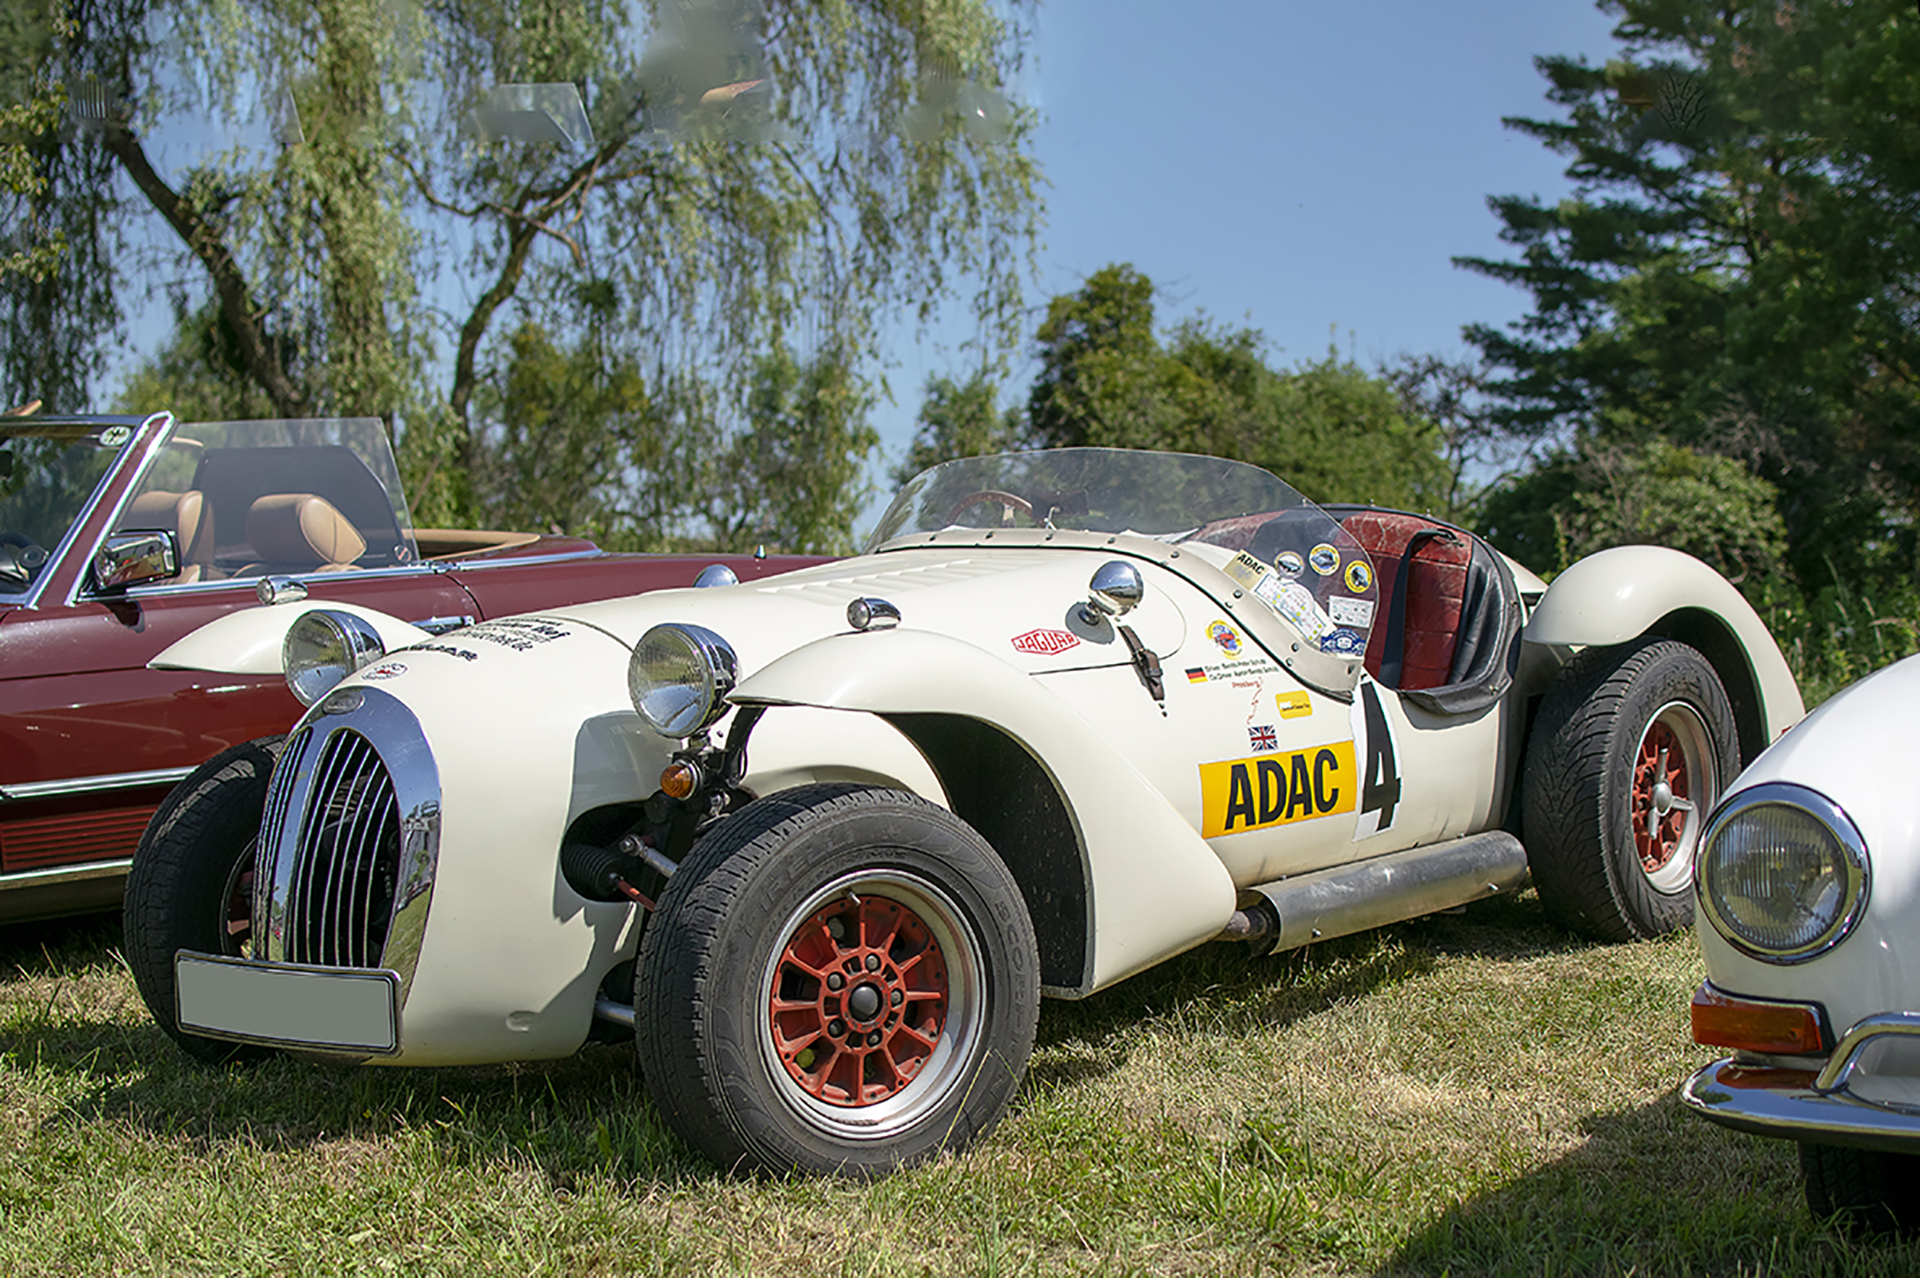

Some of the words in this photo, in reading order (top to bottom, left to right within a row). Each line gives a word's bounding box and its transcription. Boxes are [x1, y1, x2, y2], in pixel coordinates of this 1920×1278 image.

[1237, 553, 1265, 575] ADAC
[1018, 632, 1075, 651] JAGUAR
[1360, 681, 1401, 832] 4
[1224, 749, 1339, 830] ADAC
